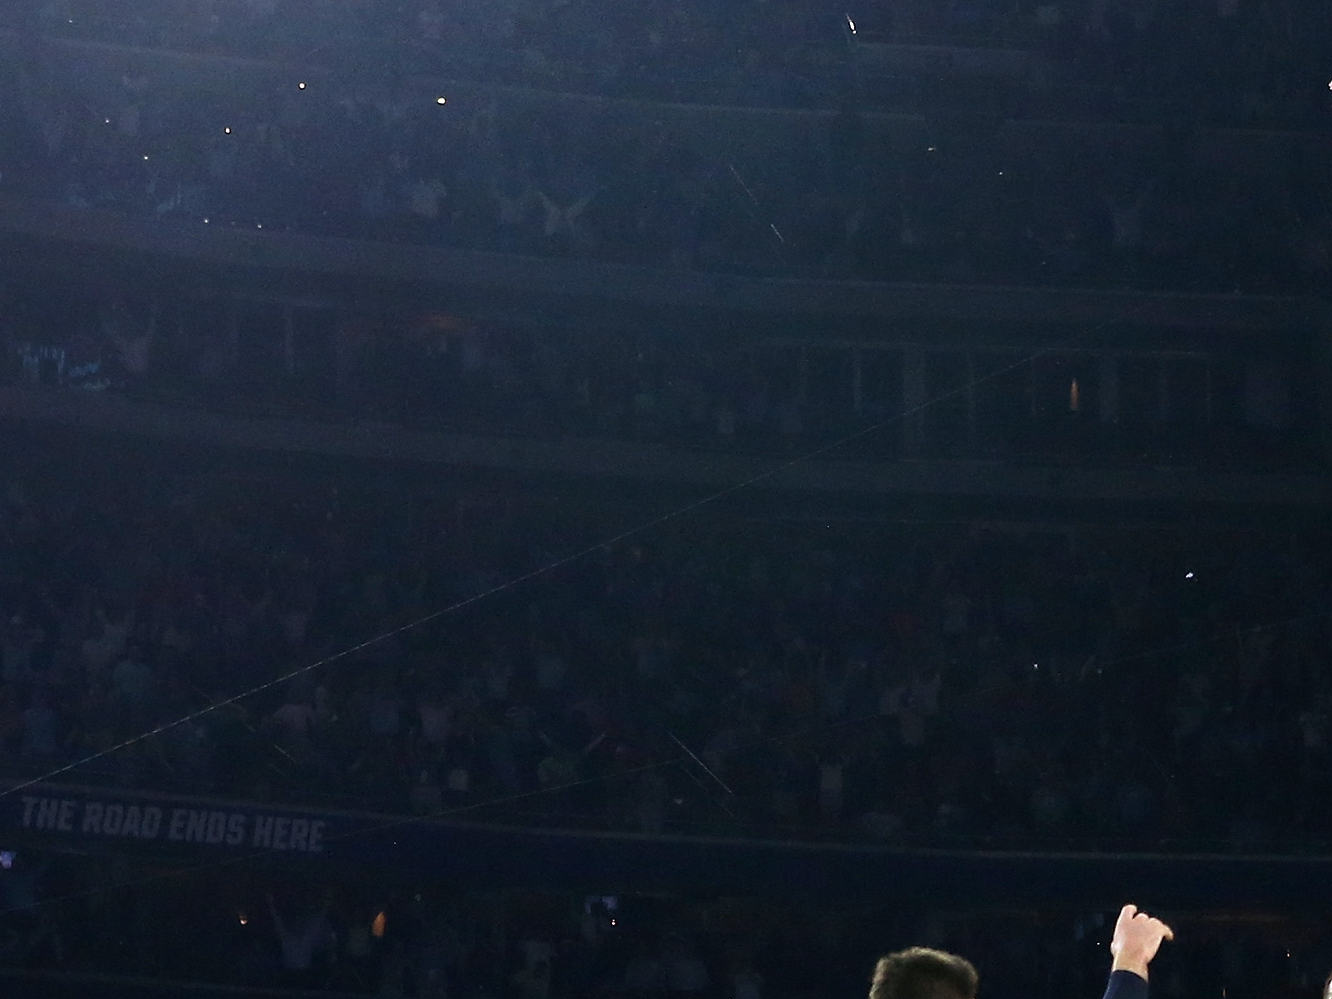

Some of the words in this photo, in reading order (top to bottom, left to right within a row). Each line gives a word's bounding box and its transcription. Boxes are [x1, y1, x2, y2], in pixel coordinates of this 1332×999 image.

[21, 796, 75, 832] THE
[82, 802, 163, 839] ROAD
[168, 808, 246, 845] ENDS
[253, 815, 326, 851] HERE
